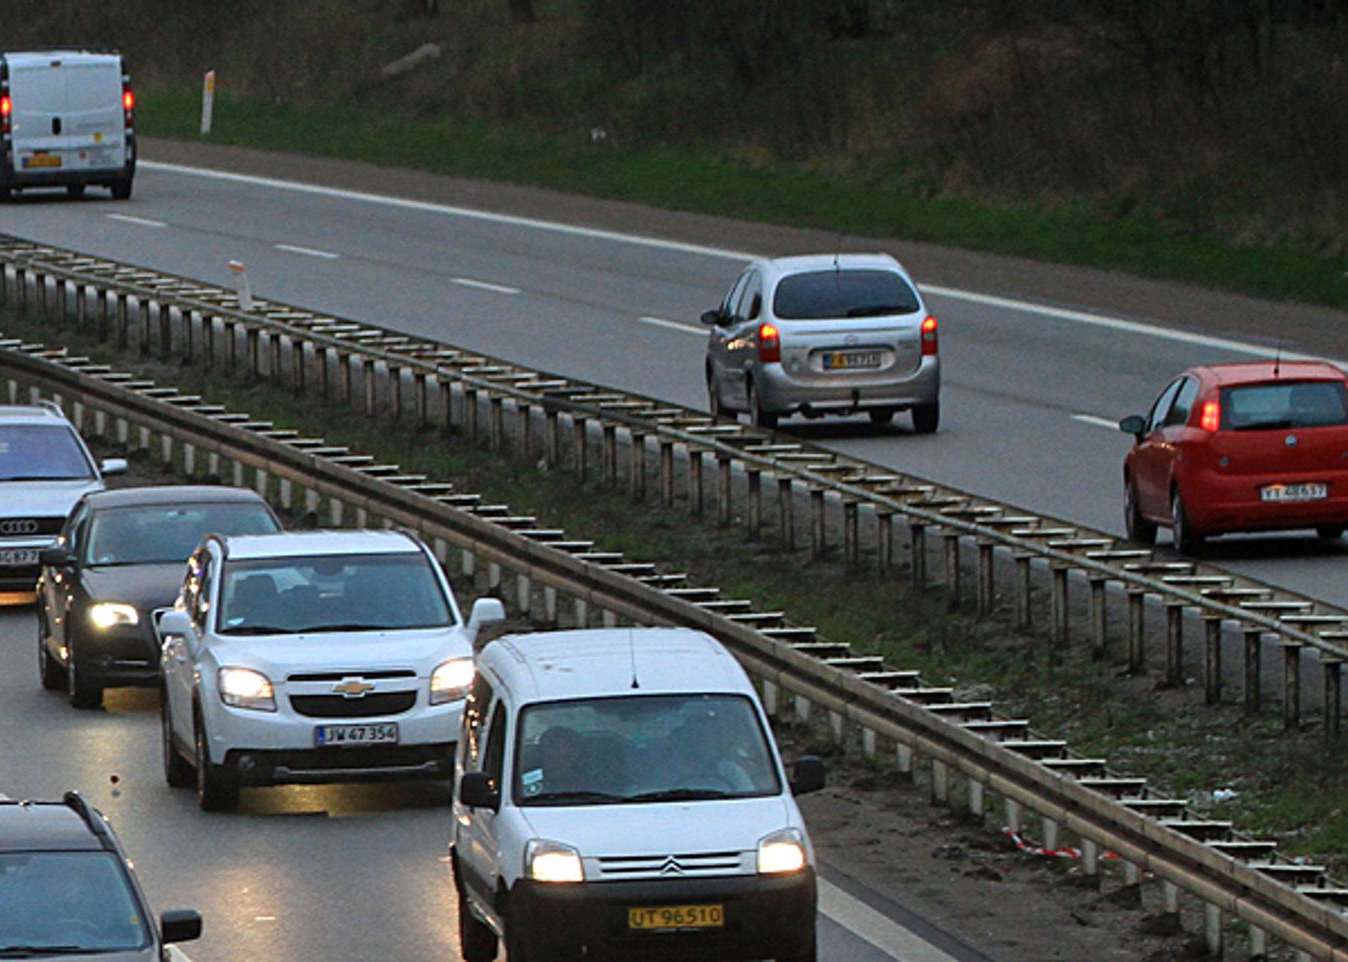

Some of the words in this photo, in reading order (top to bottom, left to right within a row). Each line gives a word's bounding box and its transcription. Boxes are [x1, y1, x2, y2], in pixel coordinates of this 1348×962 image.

[327, 728, 345, 742] JW
[348, 727, 365, 740] 47
[369, 725, 395, 740] 354
[632, 909, 657, 927] UT
